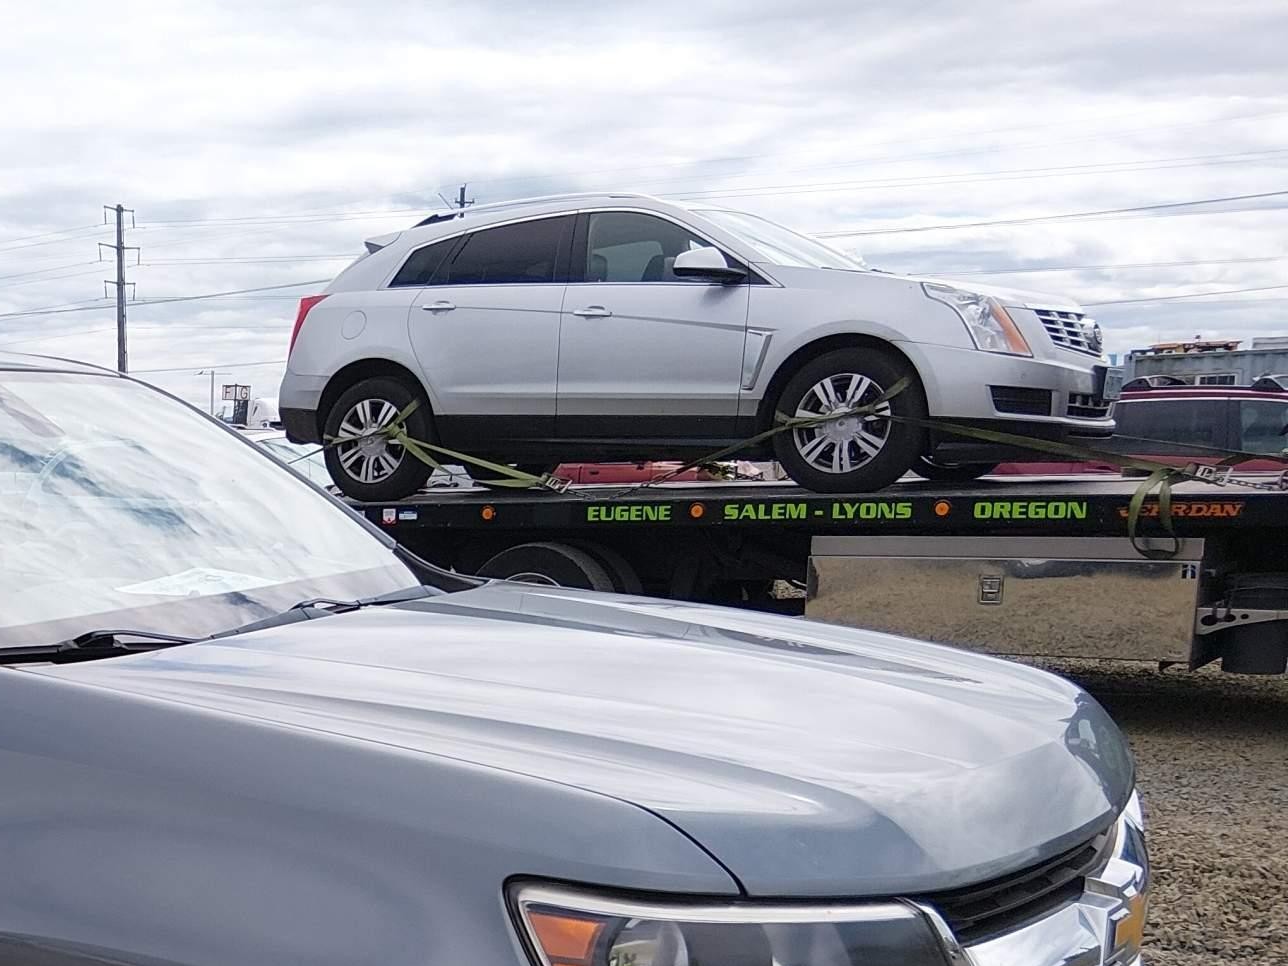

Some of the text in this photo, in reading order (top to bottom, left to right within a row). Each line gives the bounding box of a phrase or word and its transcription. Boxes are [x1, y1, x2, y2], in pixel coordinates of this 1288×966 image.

[240, 387, 249, 400] G
[587, 505, 672, 521] EUGENE
[723, 503, 807, 520] SALEM
[831, 502, 912, 519] LYONS
[973, 501, 1087, 519] OREGON
